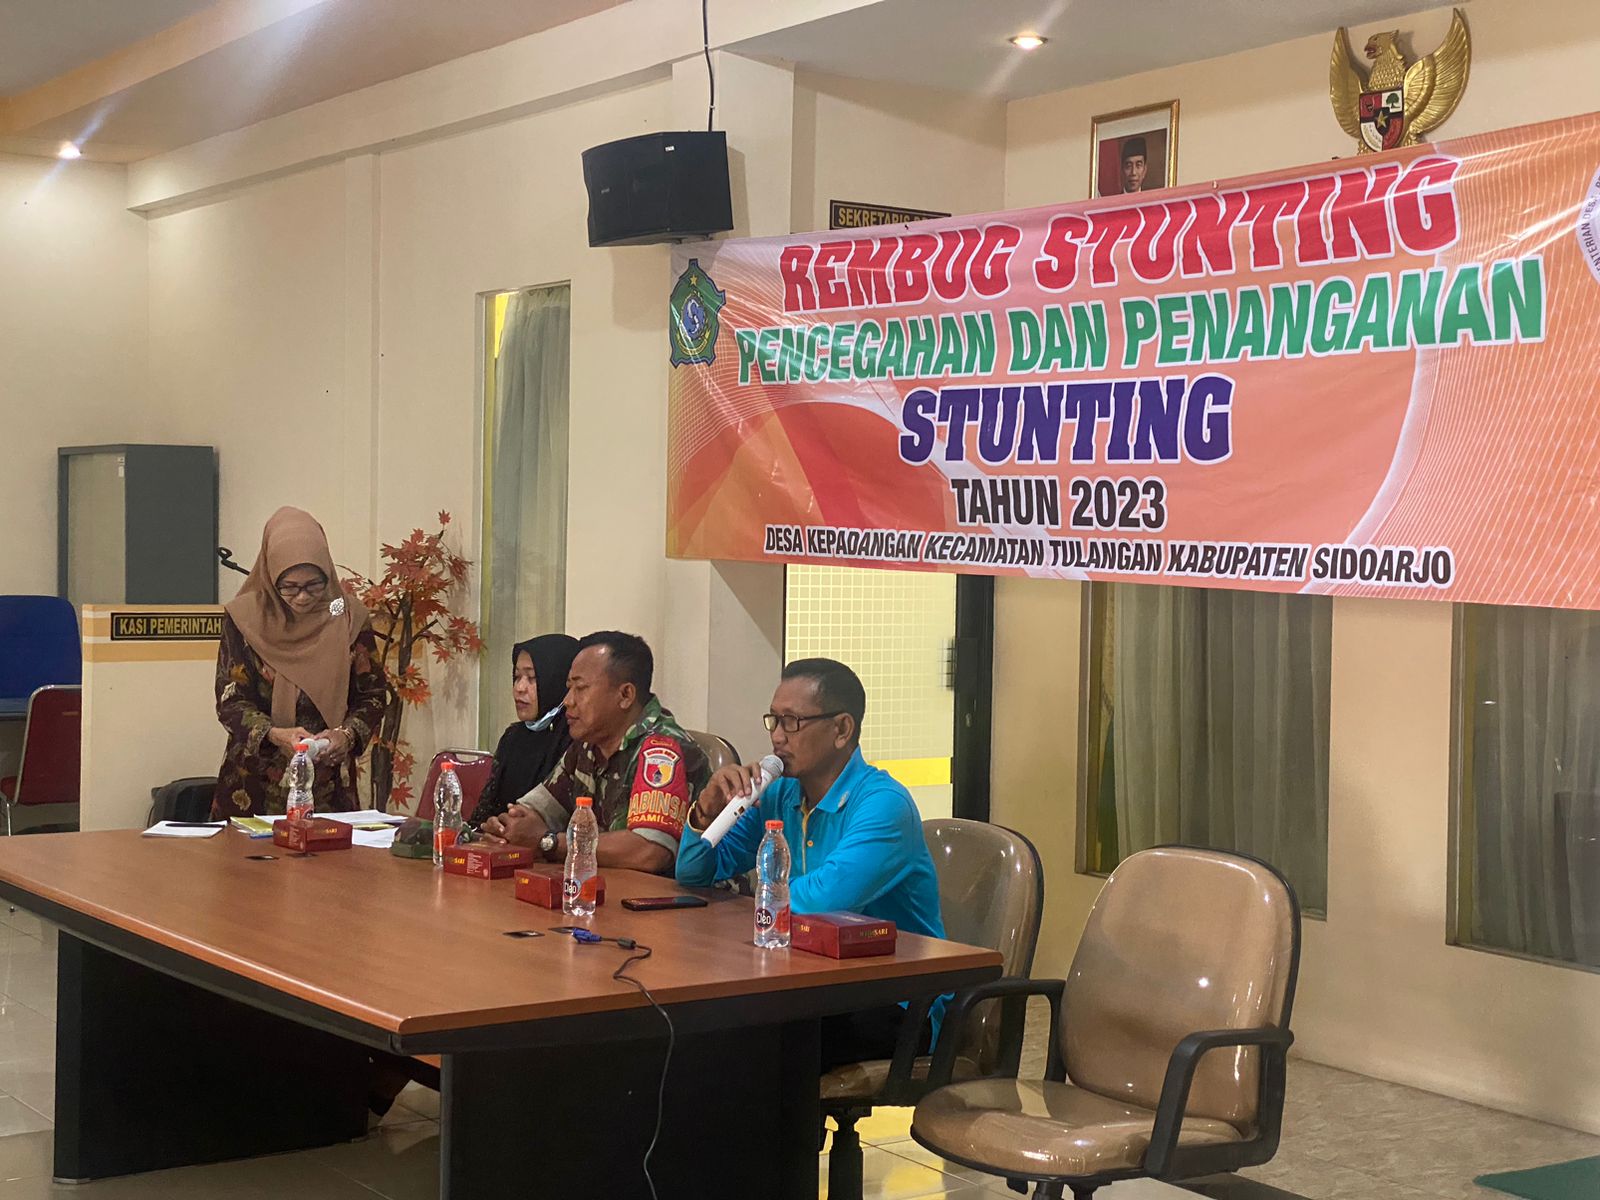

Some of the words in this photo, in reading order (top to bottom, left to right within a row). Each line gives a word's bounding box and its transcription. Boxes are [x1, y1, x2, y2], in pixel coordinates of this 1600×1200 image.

[779, 225, 1021, 314] REMBUG
[1034, 156, 1461, 293] STUNTING
[736, 310, 996, 385] PENCEGAHAN
[1007, 302, 1108, 374] DAN
[1120, 255, 1546, 369] PENANGANAN
[900, 374, 1234, 465] STUNTING
[951, 477, 1060, 527] TAHUN
[1070, 477, 1167, 531] 2023
[765, 526, 804, 554] DESA
[807, 529, 922, 560] KEPADANGAN
[924, 532, 1045, 567] KECAMATAN
[1049, 540, 1162, 573] TULANGAN
[1167, 542, 1309, 579] KABUPATEN
[1313, 546, 1453, 587] SIDOARJO
[120, 618, 147, 634] KASI
